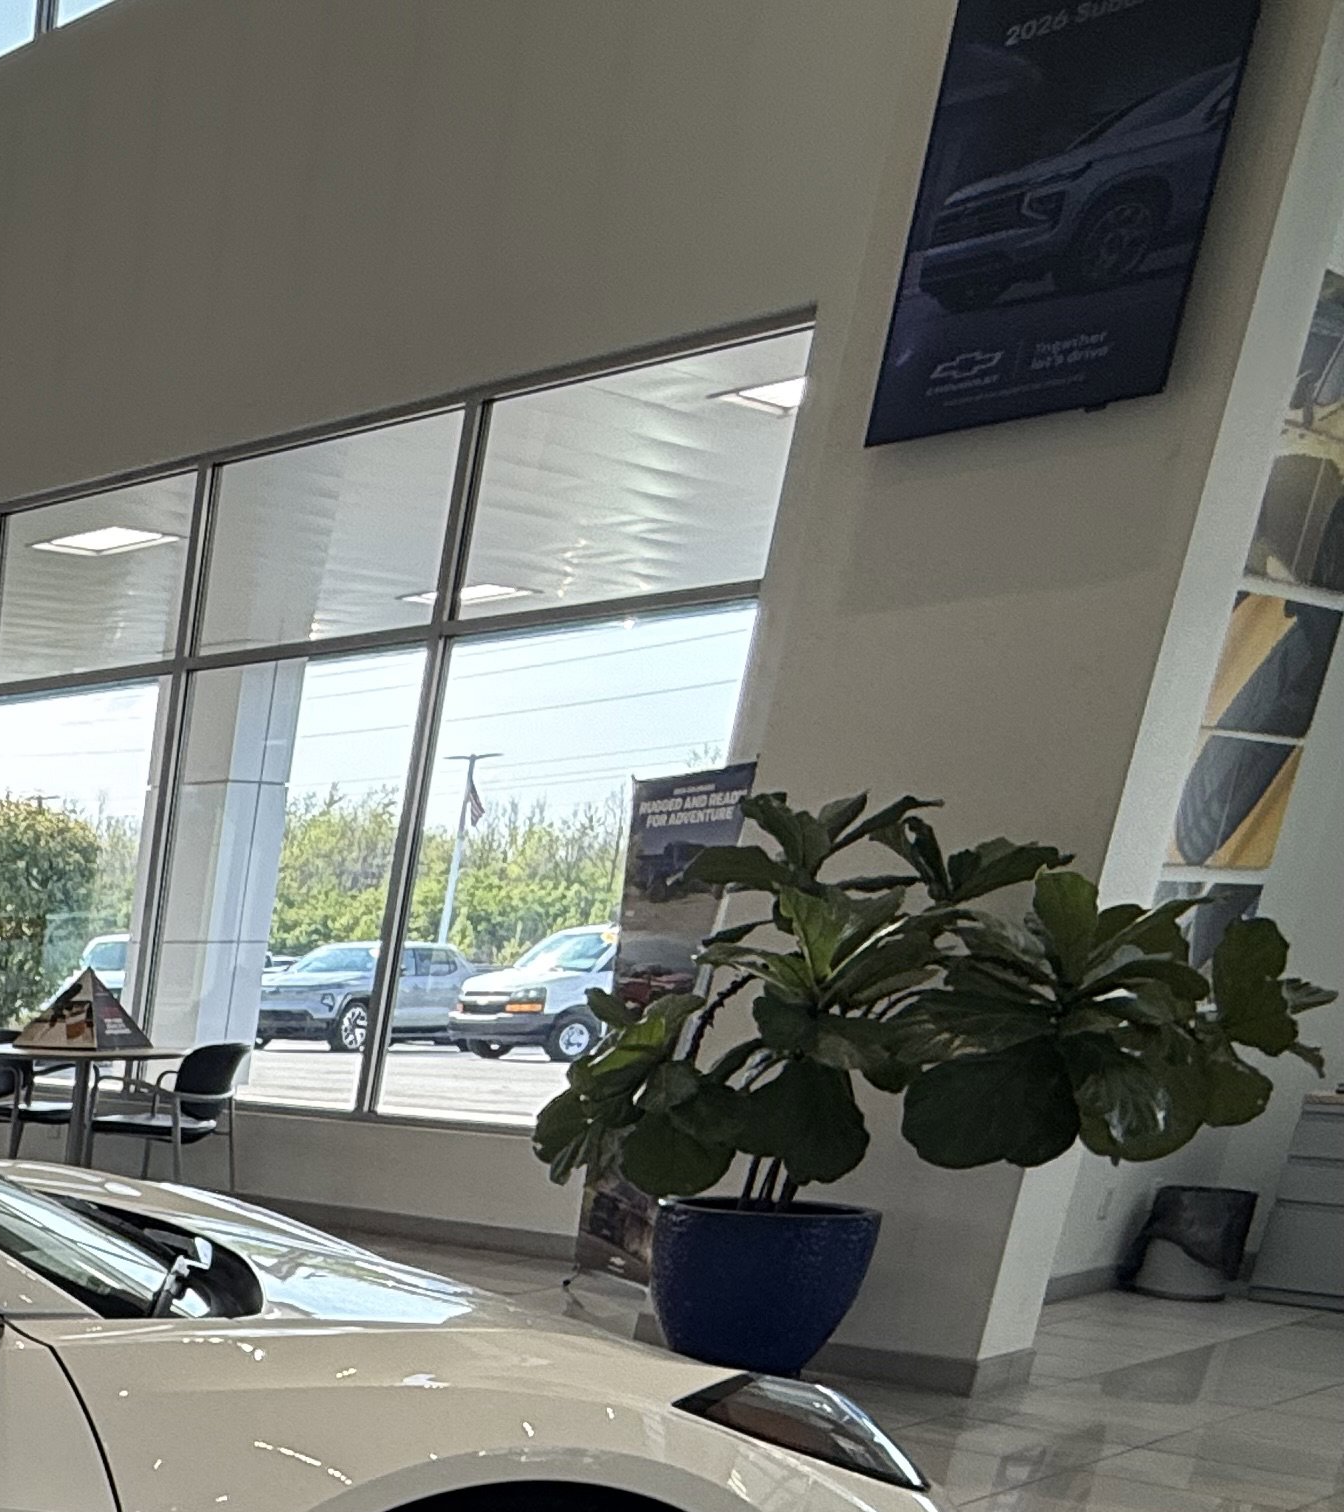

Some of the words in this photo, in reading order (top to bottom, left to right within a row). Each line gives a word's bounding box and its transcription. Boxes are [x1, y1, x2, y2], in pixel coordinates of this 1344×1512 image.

[1005, 9, 1069, 46] 2026
[639, 798, 683, 816] RUGGED
[683, 794, 709, 811] AND
[646, 814, 668, 829] FOR
[669, 806, 734, 826] ADVENTURE
